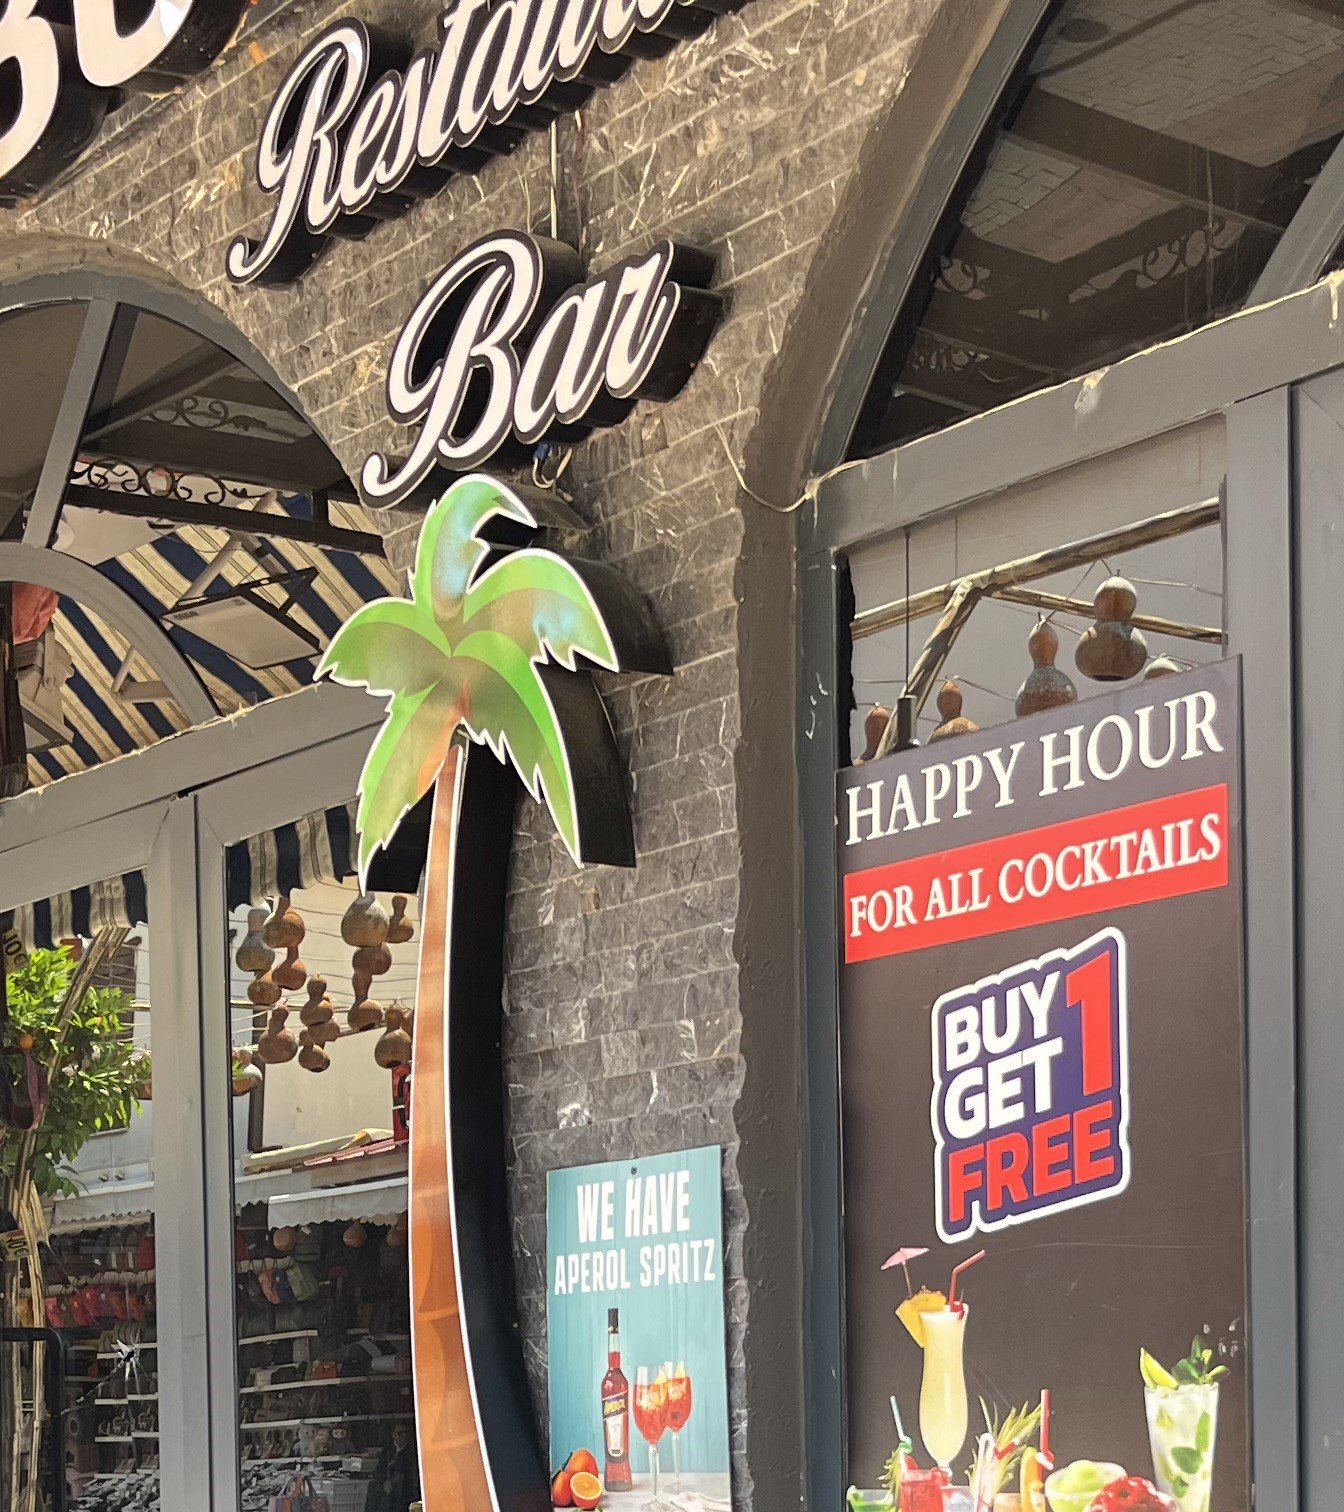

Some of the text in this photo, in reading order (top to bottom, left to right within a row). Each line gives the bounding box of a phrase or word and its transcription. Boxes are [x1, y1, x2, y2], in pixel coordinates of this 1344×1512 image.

[359, 230, 678, 508] Bar
[845, 690, 1224, 846] HAPPY HOUR
[849, 813, 1221, 938] FOR ALL COCKTAILS
[944, 950, 1113, 1097] BUY 1
[943, 1037, 1064, 1140] GET
[576, 1170, 691, 1243] WE HAVE
[948, 1100, 1115, 1223] FREE
[554, 1238, 716, 1296] APEROL SPRITZ
